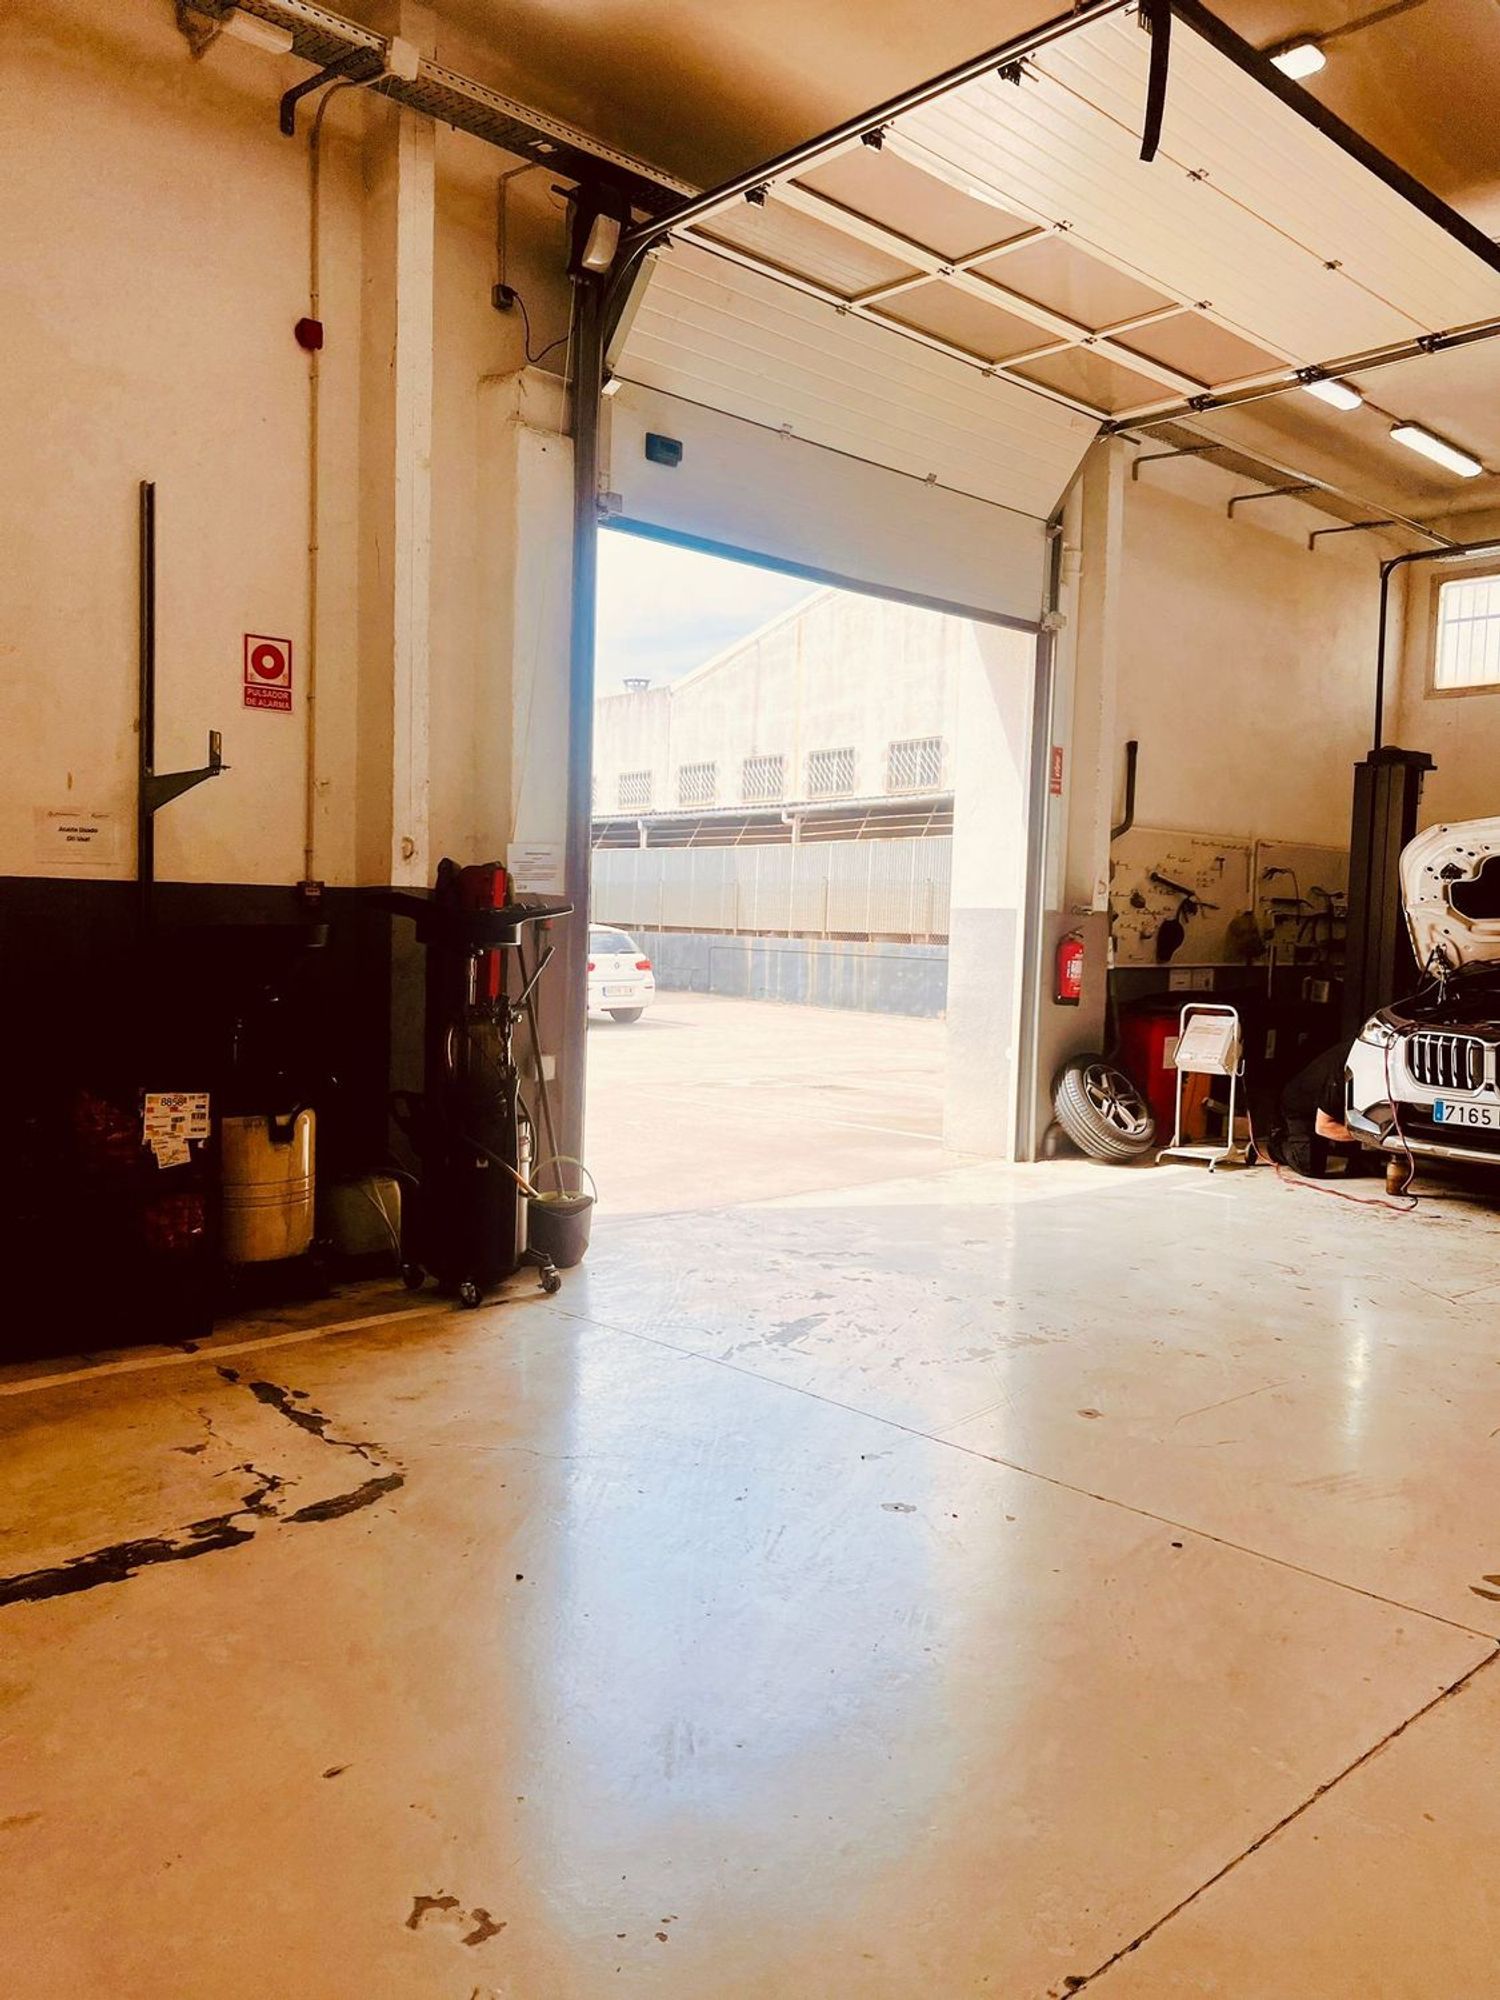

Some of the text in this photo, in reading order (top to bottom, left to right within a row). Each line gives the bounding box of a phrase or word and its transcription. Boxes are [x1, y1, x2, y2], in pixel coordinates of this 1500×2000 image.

[246, 688, 289, 699] PULSADOR
[246, 697, 291, 709] DE ALARMA
[1445, 1105, 1491, 1125] 7165
